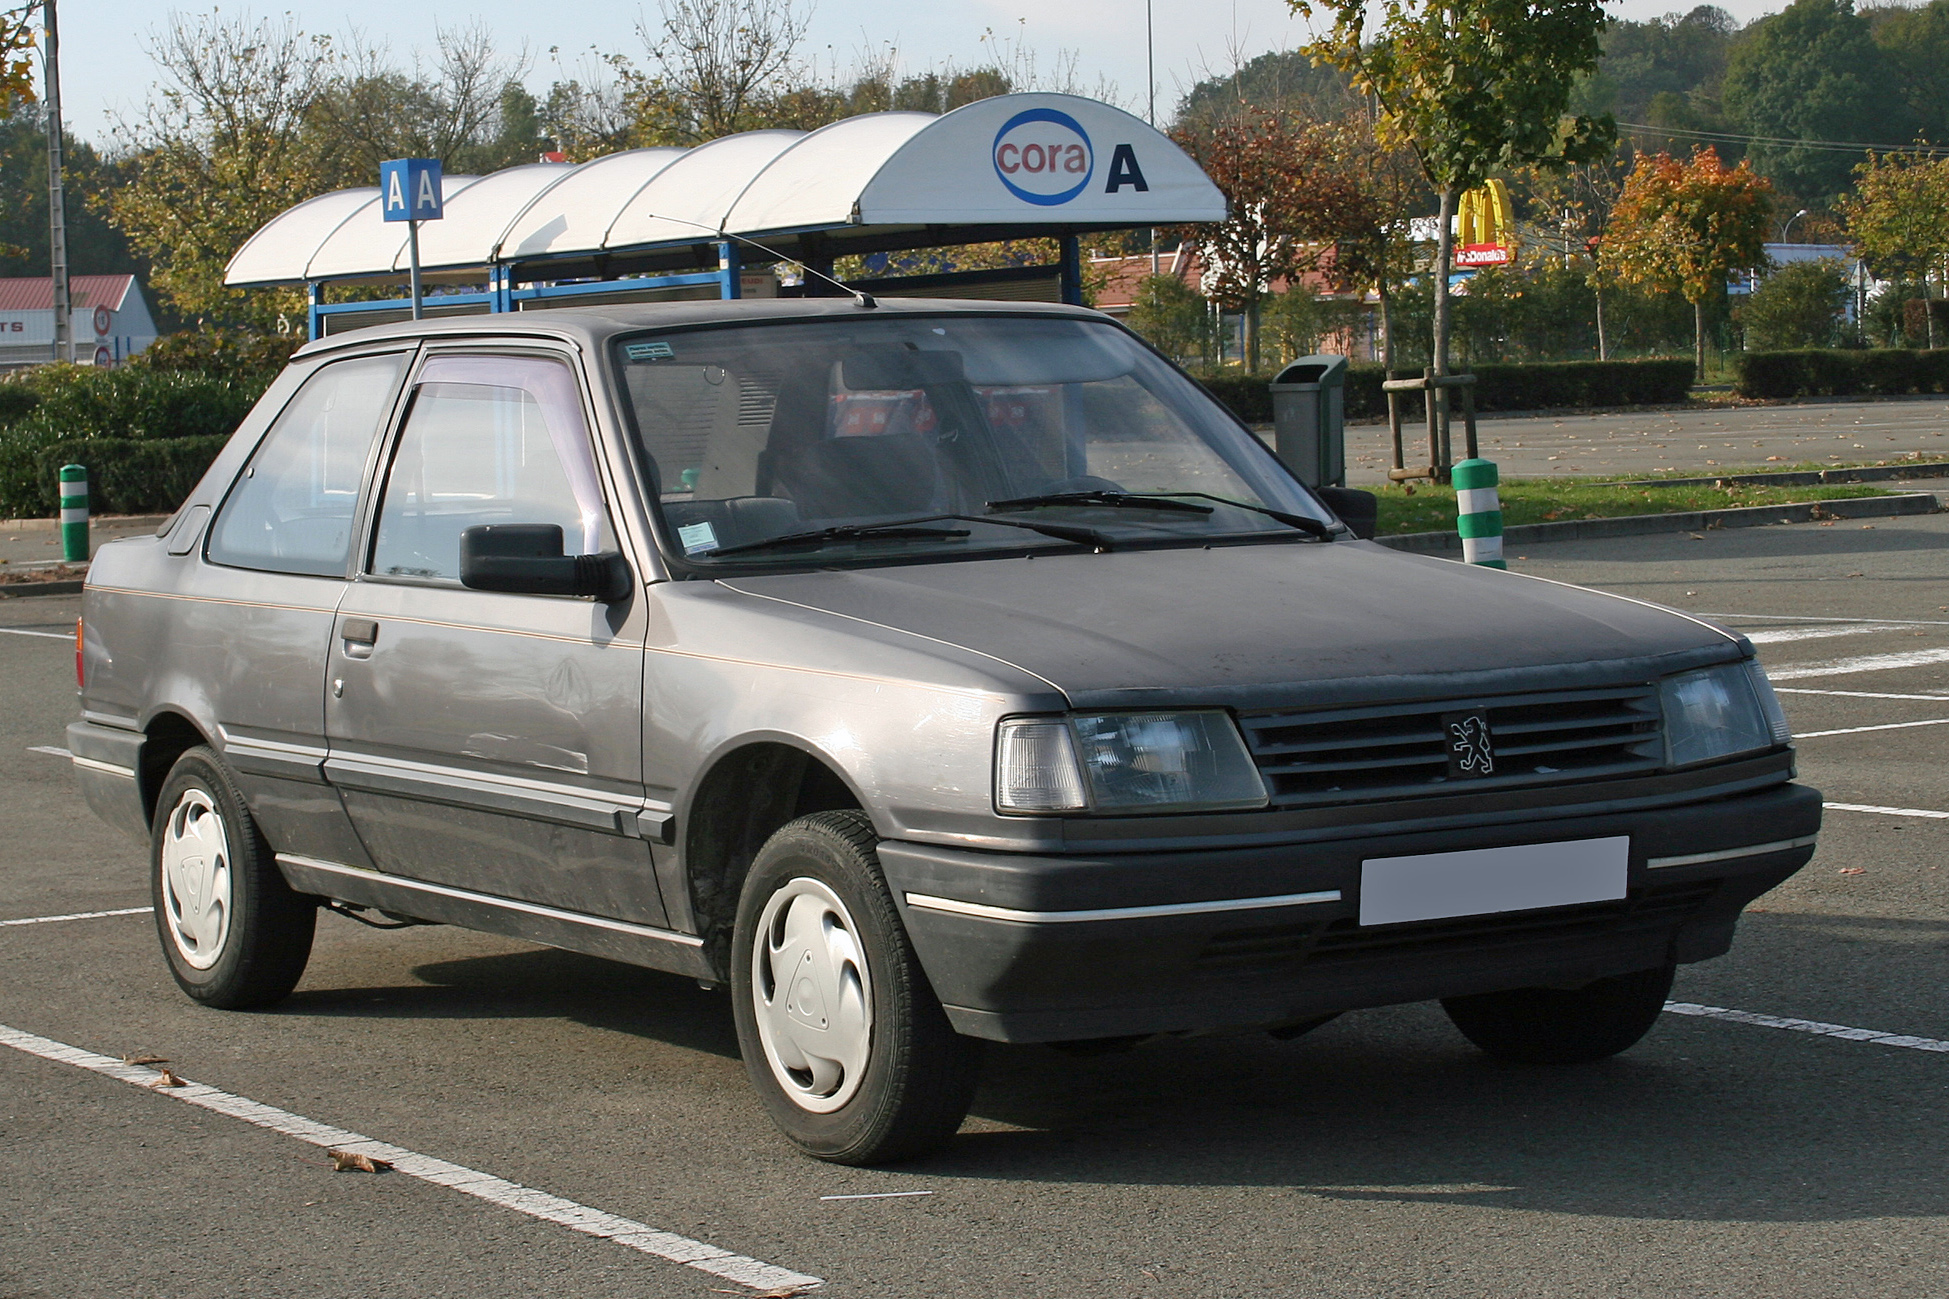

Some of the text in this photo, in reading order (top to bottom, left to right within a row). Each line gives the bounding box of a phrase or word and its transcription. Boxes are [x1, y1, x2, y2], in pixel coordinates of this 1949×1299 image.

[997, 143, 1086, 174] cora
[1105, 144, 1149, 193] A
[387, 171, 405, 211] A
[417, 170, 437, 209] A
